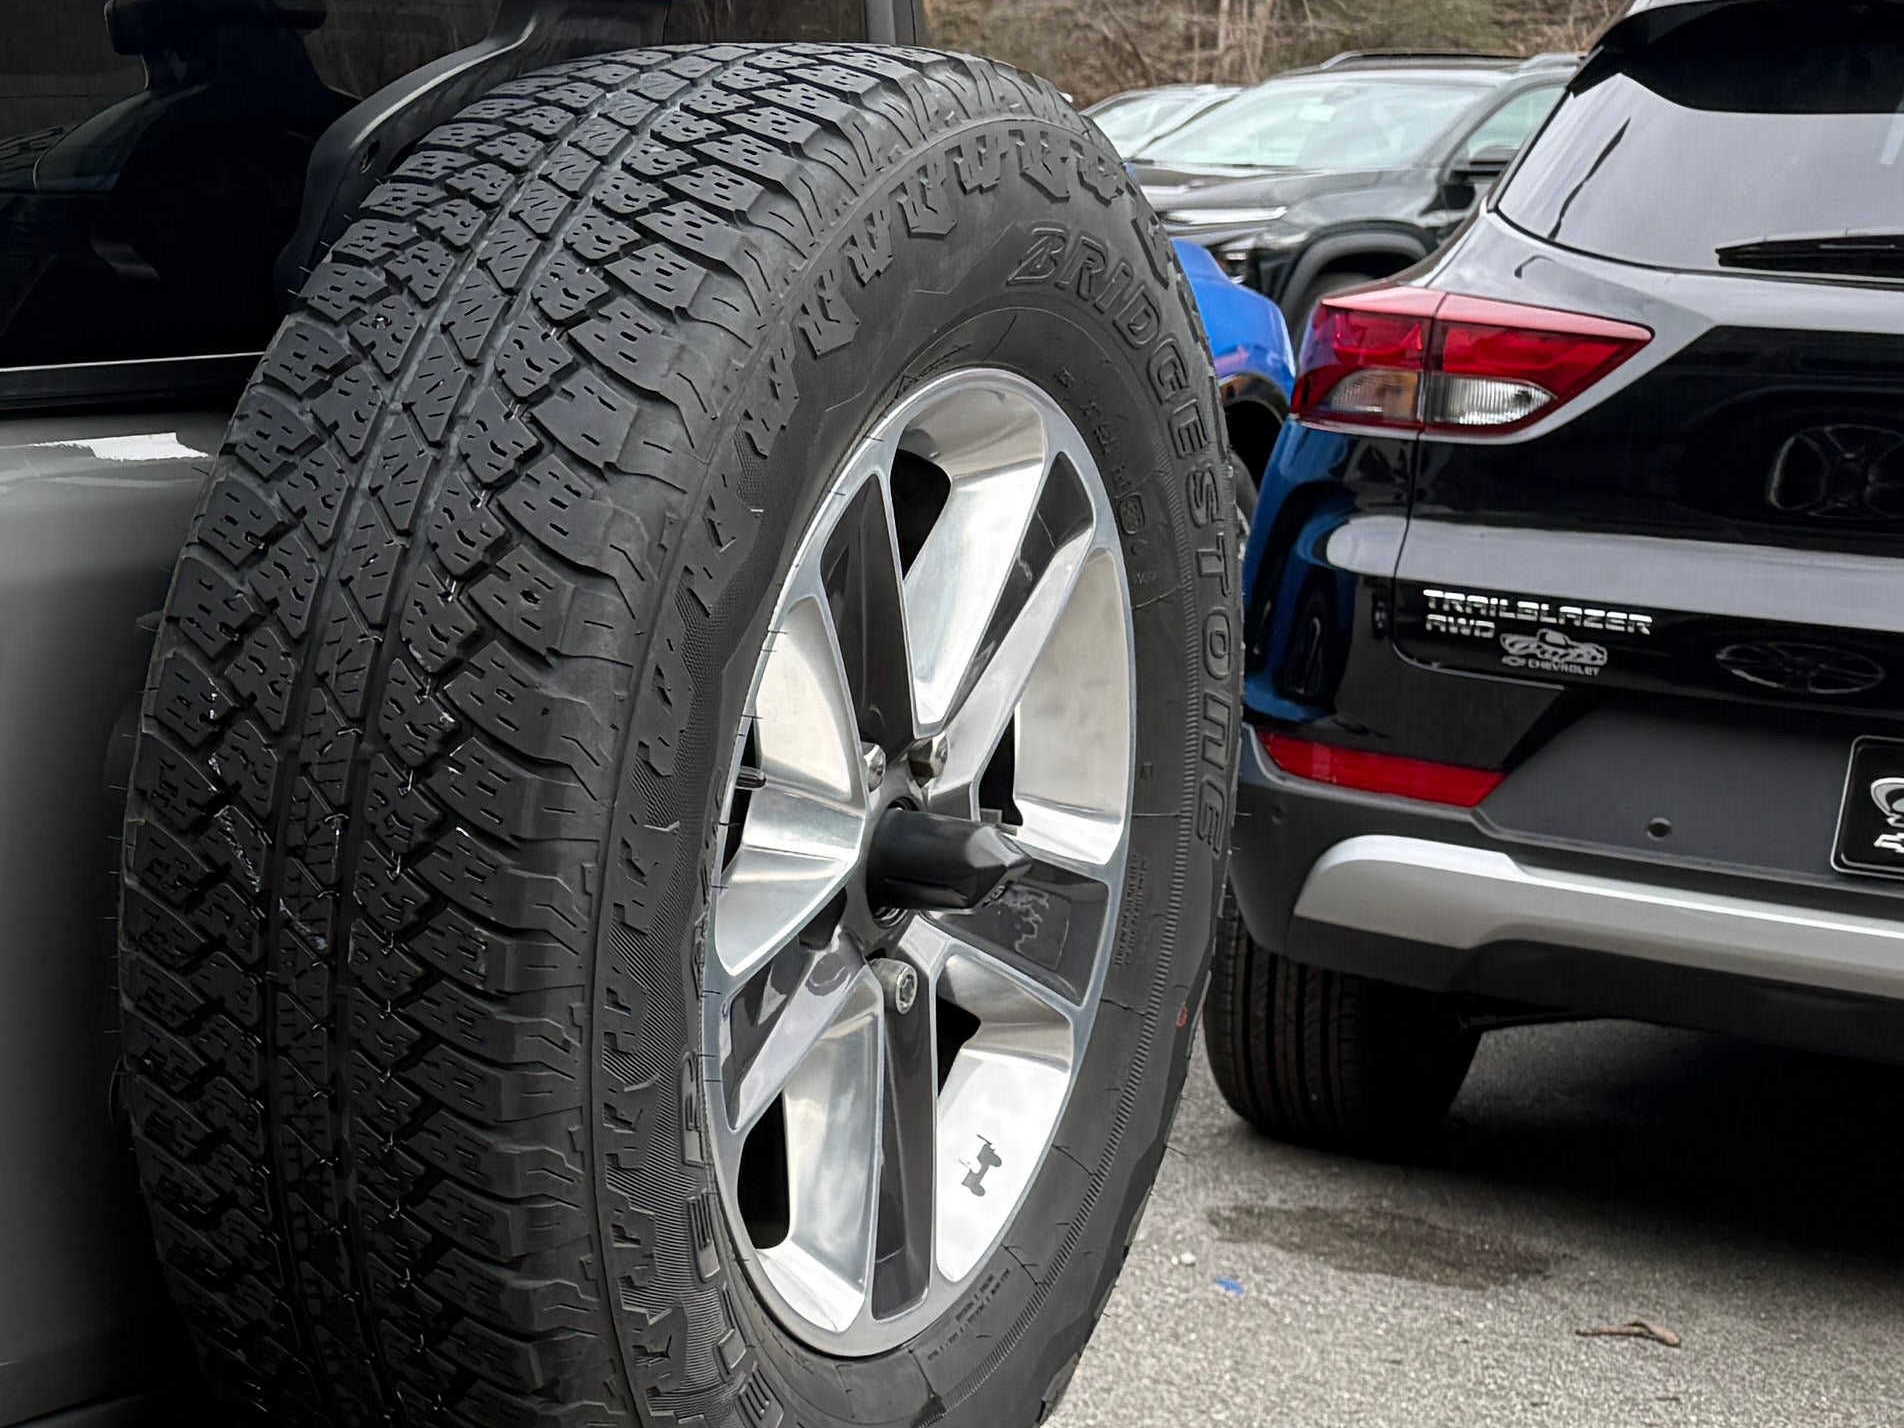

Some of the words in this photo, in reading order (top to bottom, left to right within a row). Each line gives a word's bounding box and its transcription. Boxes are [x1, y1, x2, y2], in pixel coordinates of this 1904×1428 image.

[1004, 222, 1235, 857] BRIDGESTONE
[1423, 589, 1653, 635] TRAILBLAZER
[1425, 614, 1496, 638] AWD
[1527, 658, 1601, 677] CHEVROLET
